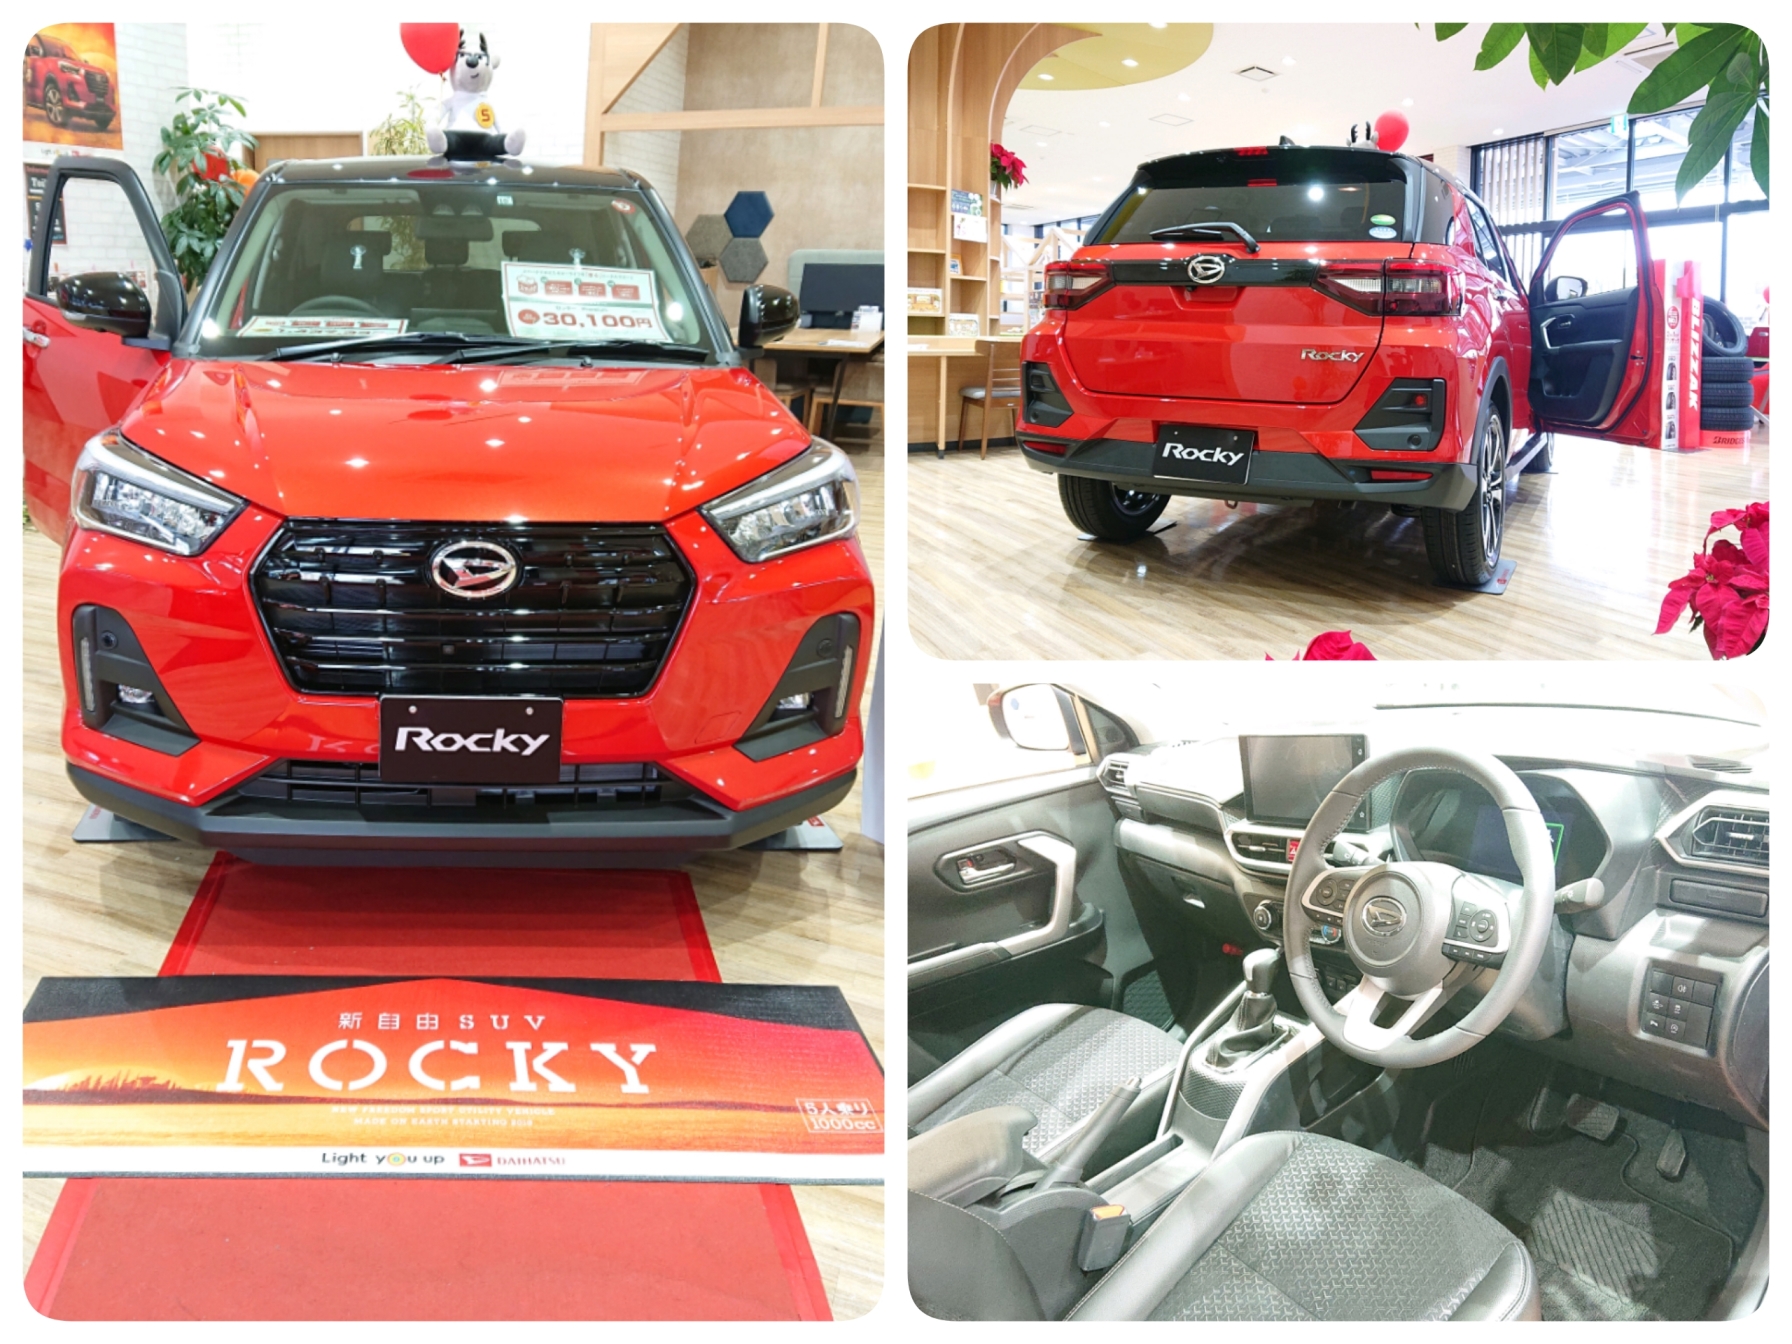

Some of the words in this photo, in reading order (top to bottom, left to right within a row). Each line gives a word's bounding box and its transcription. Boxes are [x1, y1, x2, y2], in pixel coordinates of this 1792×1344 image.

[481, 109, 491, 122] 5
[542, 311, 653, 329] 30,100円
[1300, 348, 1365, 364] Rocky
[1689, 297, 1701, 412] BLIZZAK
[1161, 442, 1245, 467] Rocky
[395, 728, 550, 756] Rocky
[215, 1038, 658, 1095] ROCKY
[331, 1105, 359, 1114] NEW
[361, 1106, 416, 1115] FREEDOM
[419, 1106, 454, 1116] SPORT
[458, 1107, 501, 1116] UTILITY
[505, 1107, 556, 1116] VEHICLE
[353, 1117, 387, 1126] MADE
[390, 1117, 407, 1126] ON
[411, 1117, 448, 1126] EARTH
[452, 1117, 507, 1127] STARTING
[810, 1116, 877, 1131] 1000cc
[321, 1152, 367, 1166] Light
[375, 1151, 417, 1167] you
[423, 1154, 445, 1166] up
[496, 1156, 566, 1166] DAIHATSU
